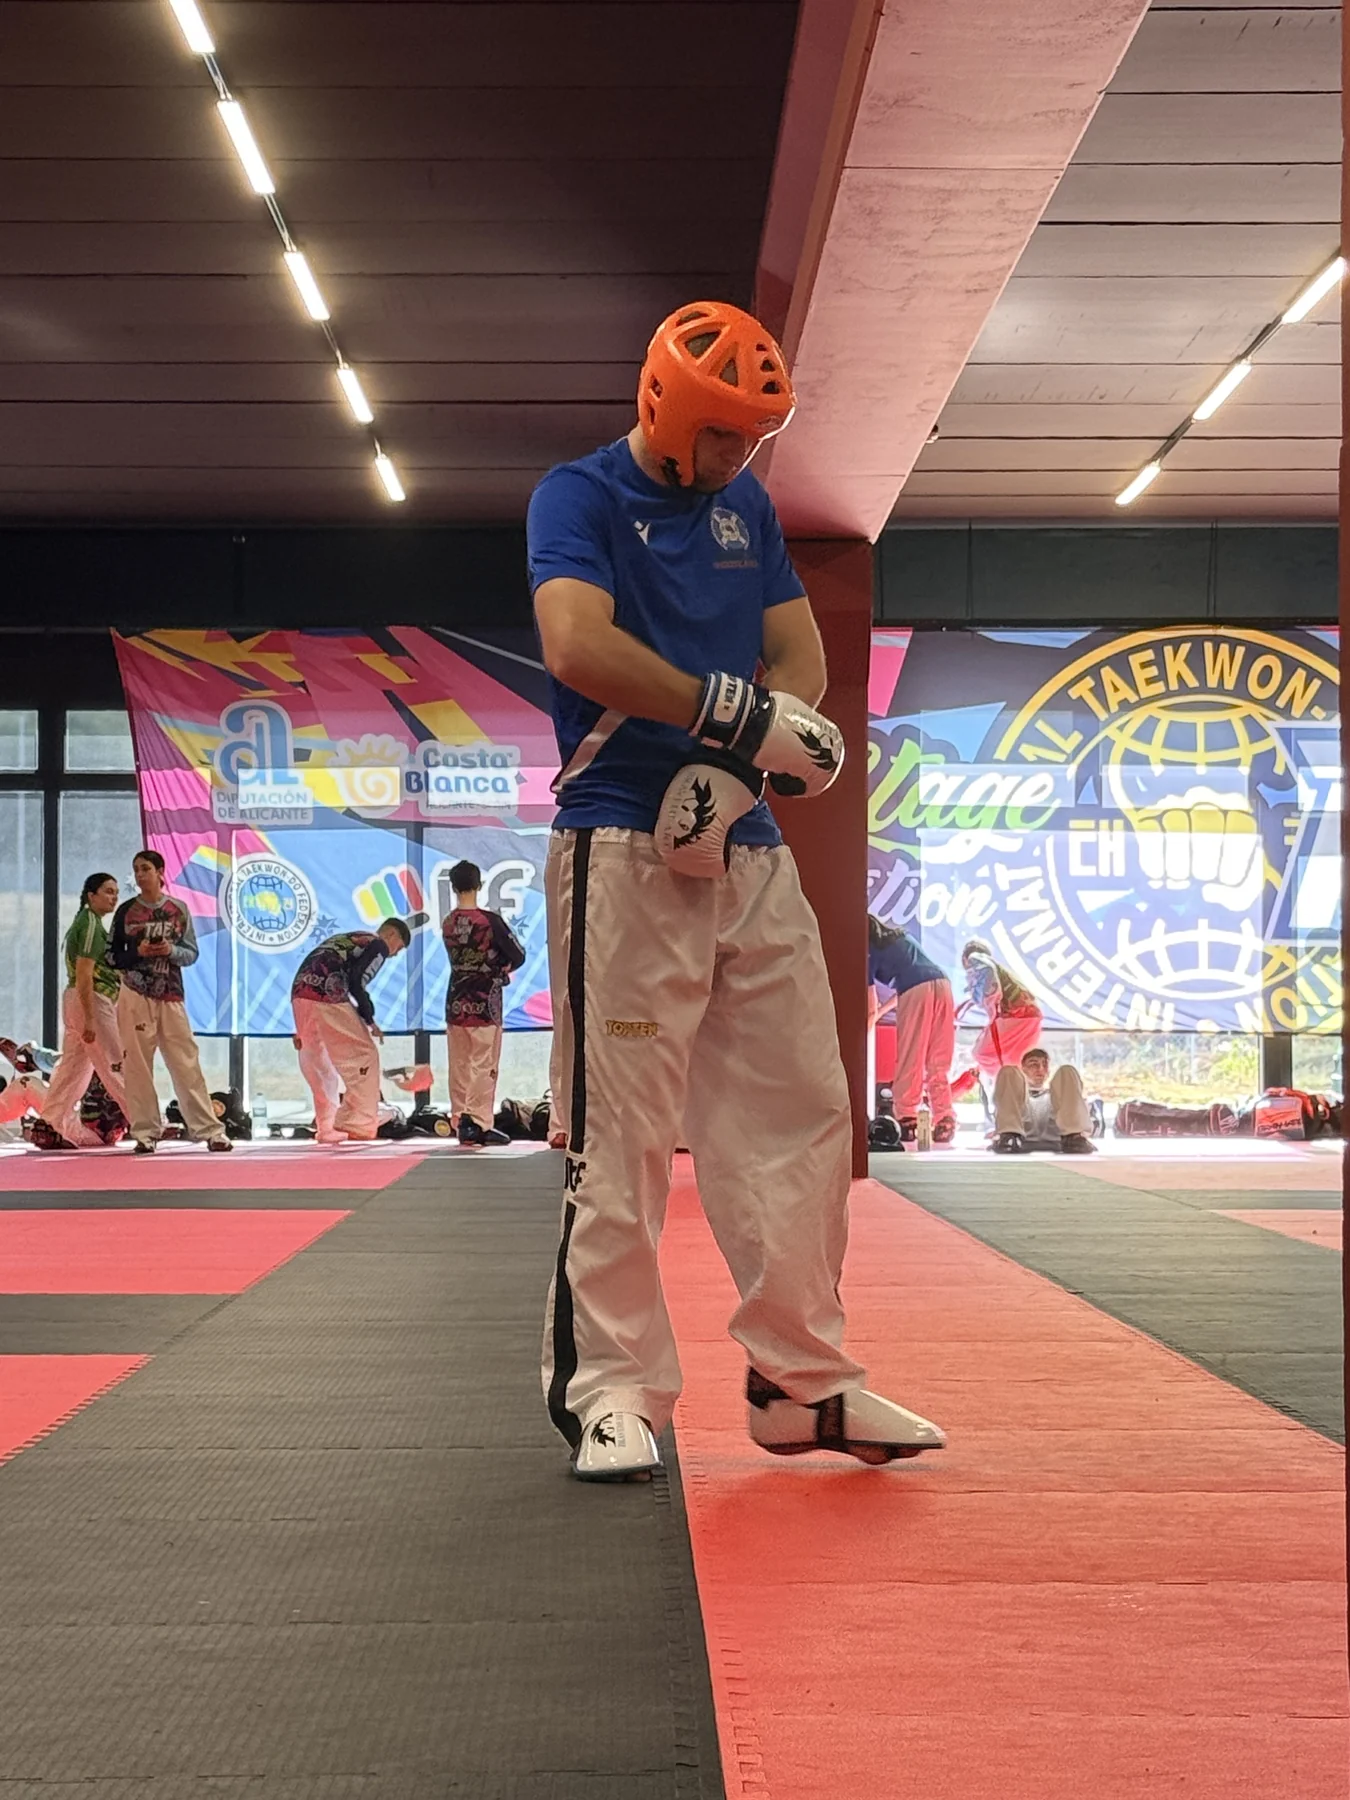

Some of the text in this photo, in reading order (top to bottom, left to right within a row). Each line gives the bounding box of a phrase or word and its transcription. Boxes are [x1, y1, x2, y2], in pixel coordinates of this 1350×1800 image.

[423, 747, 509, 768] Costa
[405, 770, 511, 793] Blanca
[216, 789, 308, 804] DIPUTACIÓN
[217, 807, 309, 820] DE ALICANTE
